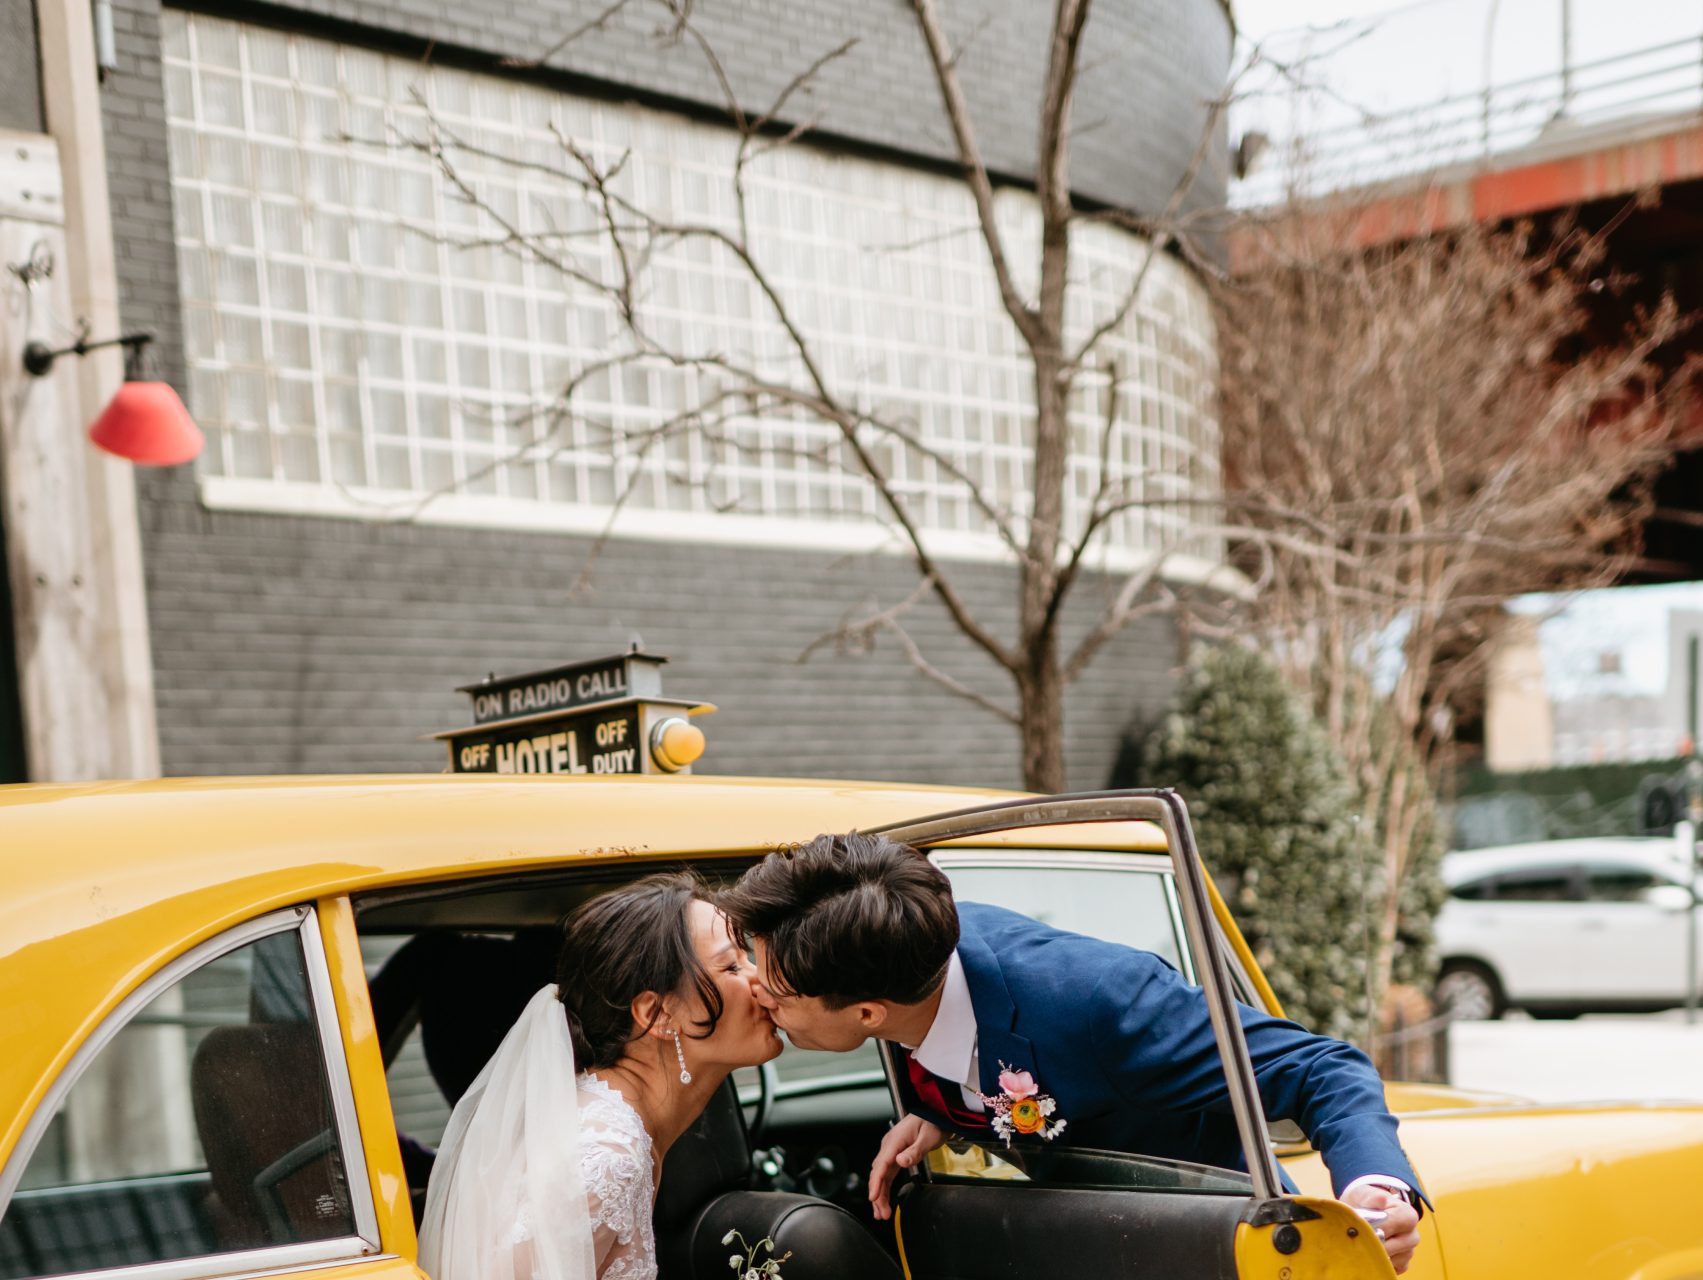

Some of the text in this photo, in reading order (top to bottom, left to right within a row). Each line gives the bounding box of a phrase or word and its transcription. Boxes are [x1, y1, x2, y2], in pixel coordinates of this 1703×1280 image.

[475, 668, 627, 719] ON RADIO CALL
[595, 719, 628, 746] OFF
[461, 731, 587, 774] OFF HOTEL
[592, 748, 635, 774] DUTY
